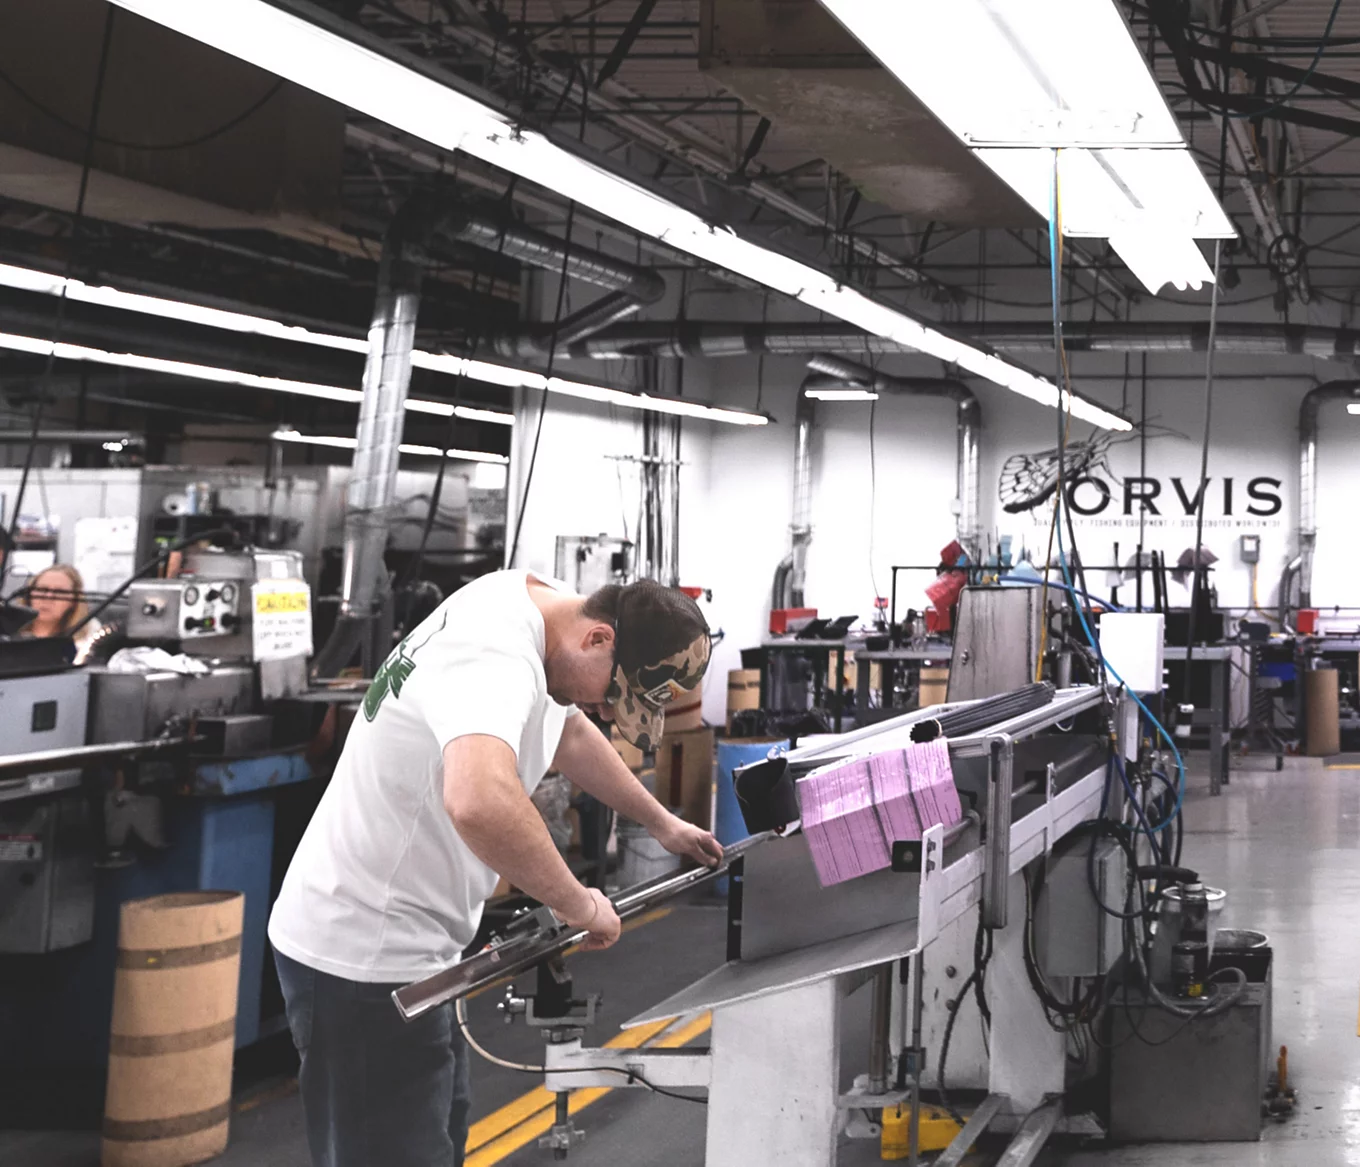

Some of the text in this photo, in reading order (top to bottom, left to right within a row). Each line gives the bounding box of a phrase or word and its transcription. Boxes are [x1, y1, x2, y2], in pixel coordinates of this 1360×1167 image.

[1067, 476, 1283, 516] ORVIS
[1033, 519, 1067, 527] QUALY
[1125, 519, 1168, 527] EQUPMENT
